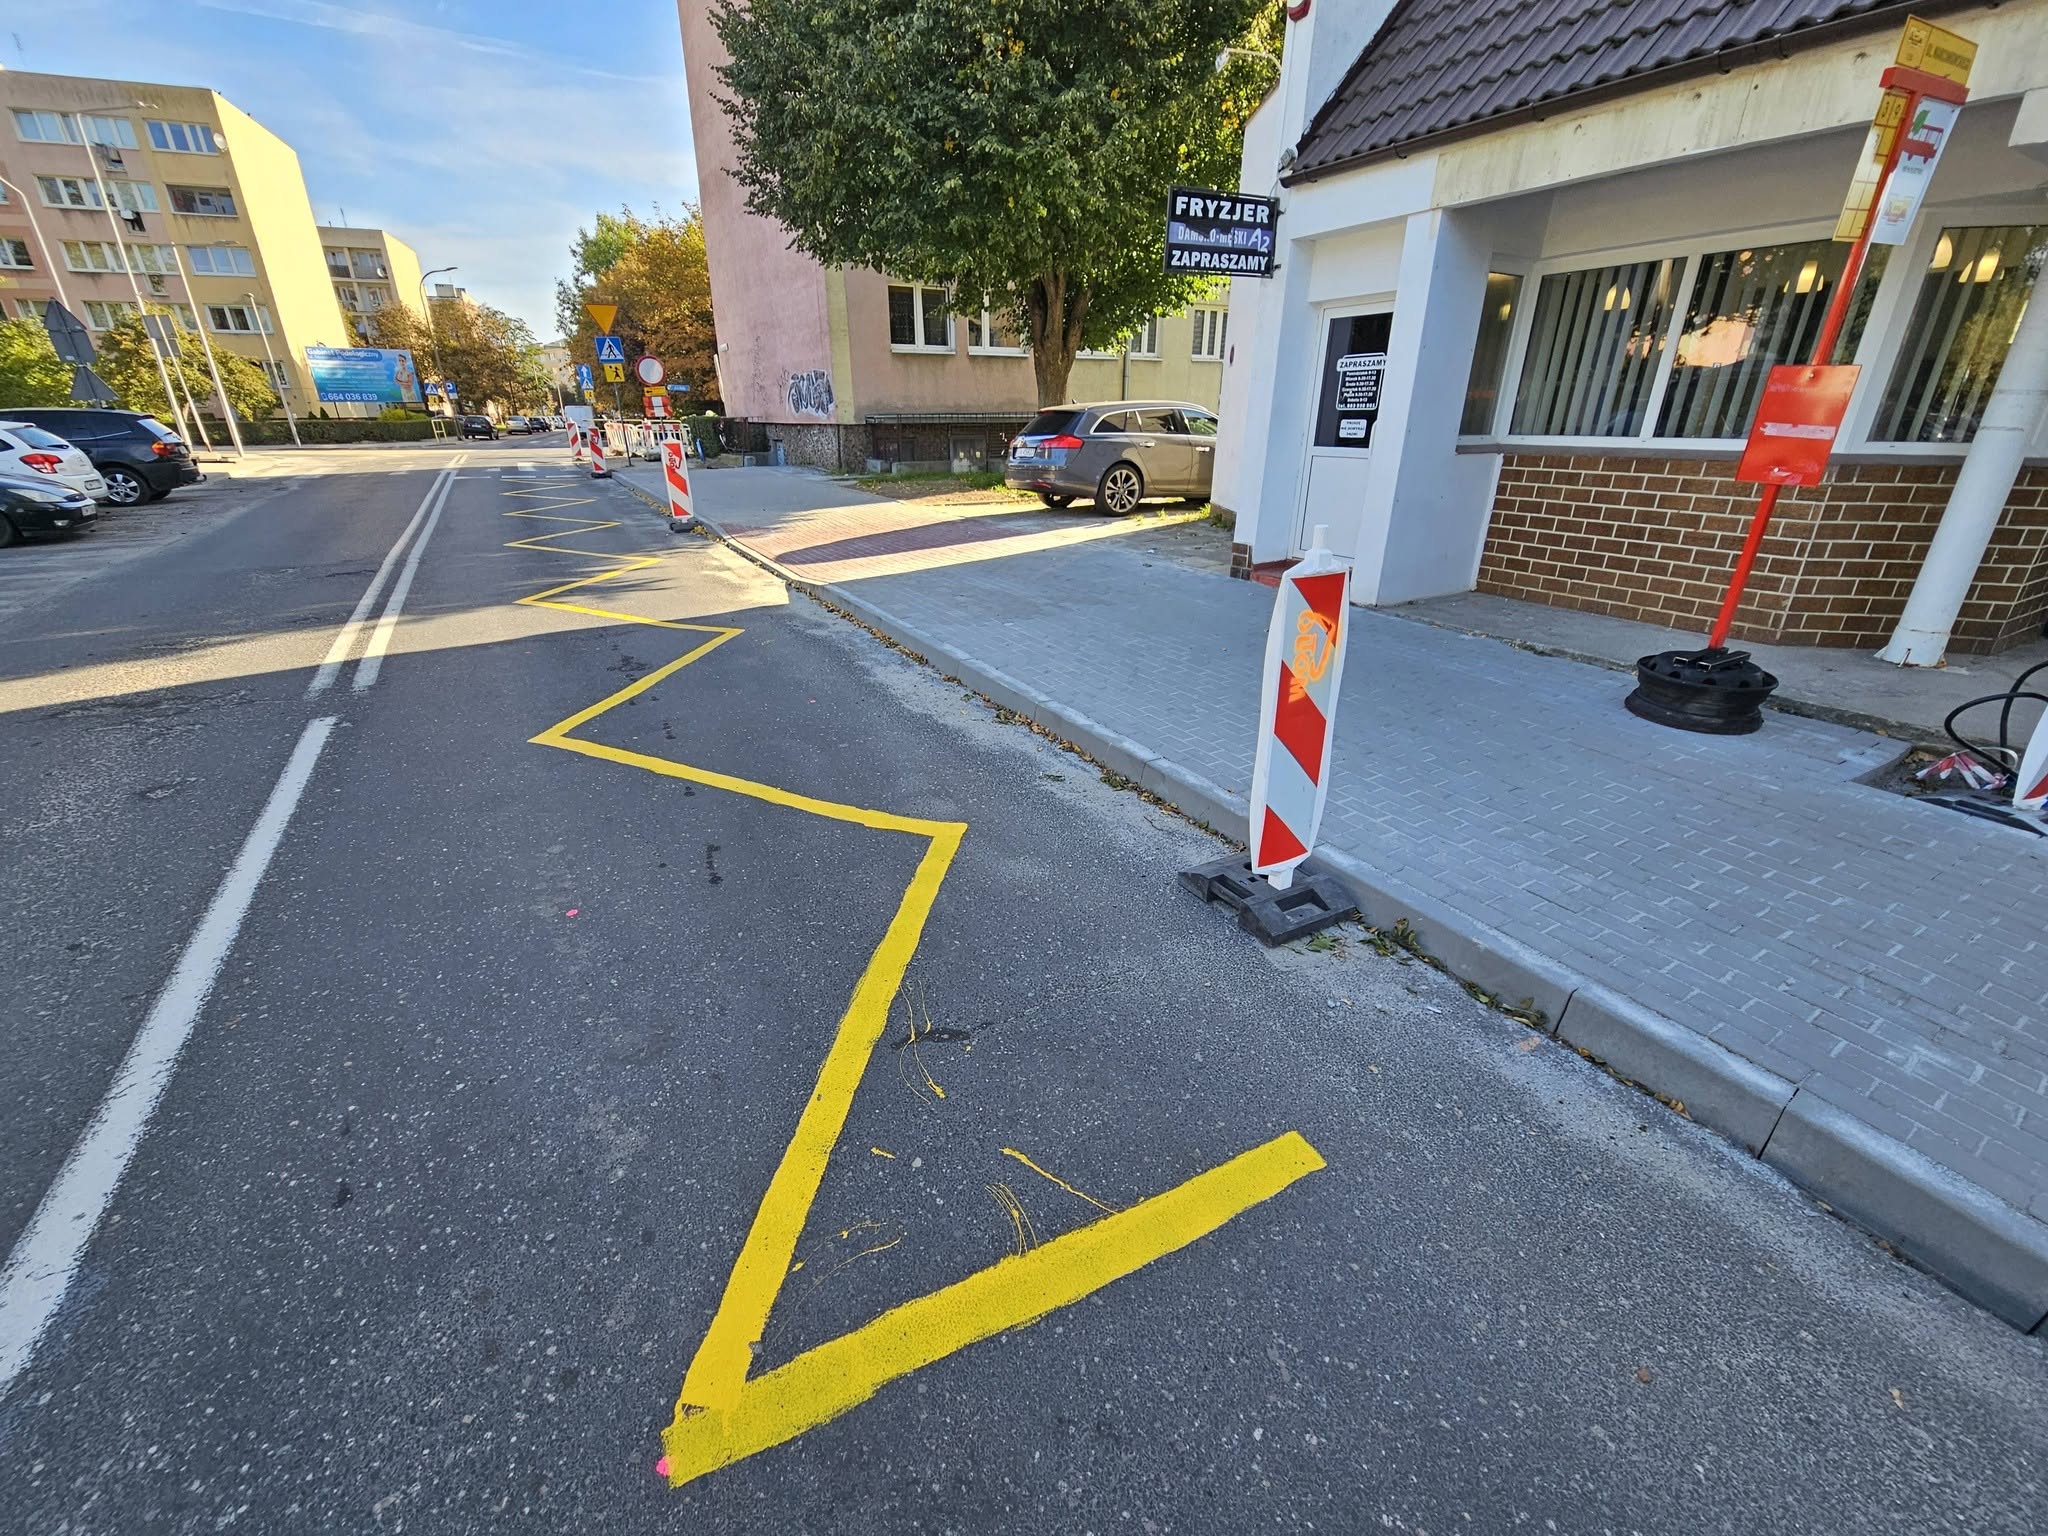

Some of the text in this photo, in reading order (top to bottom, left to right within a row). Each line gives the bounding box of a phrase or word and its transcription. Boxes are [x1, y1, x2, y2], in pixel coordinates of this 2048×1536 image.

[1175, 196, 1270, 223] FRYZJER
[1171, 250, 1268, 271] ZAPRASZAMY
[1339, 359, 1386, 369] ZAPRASZAMY
